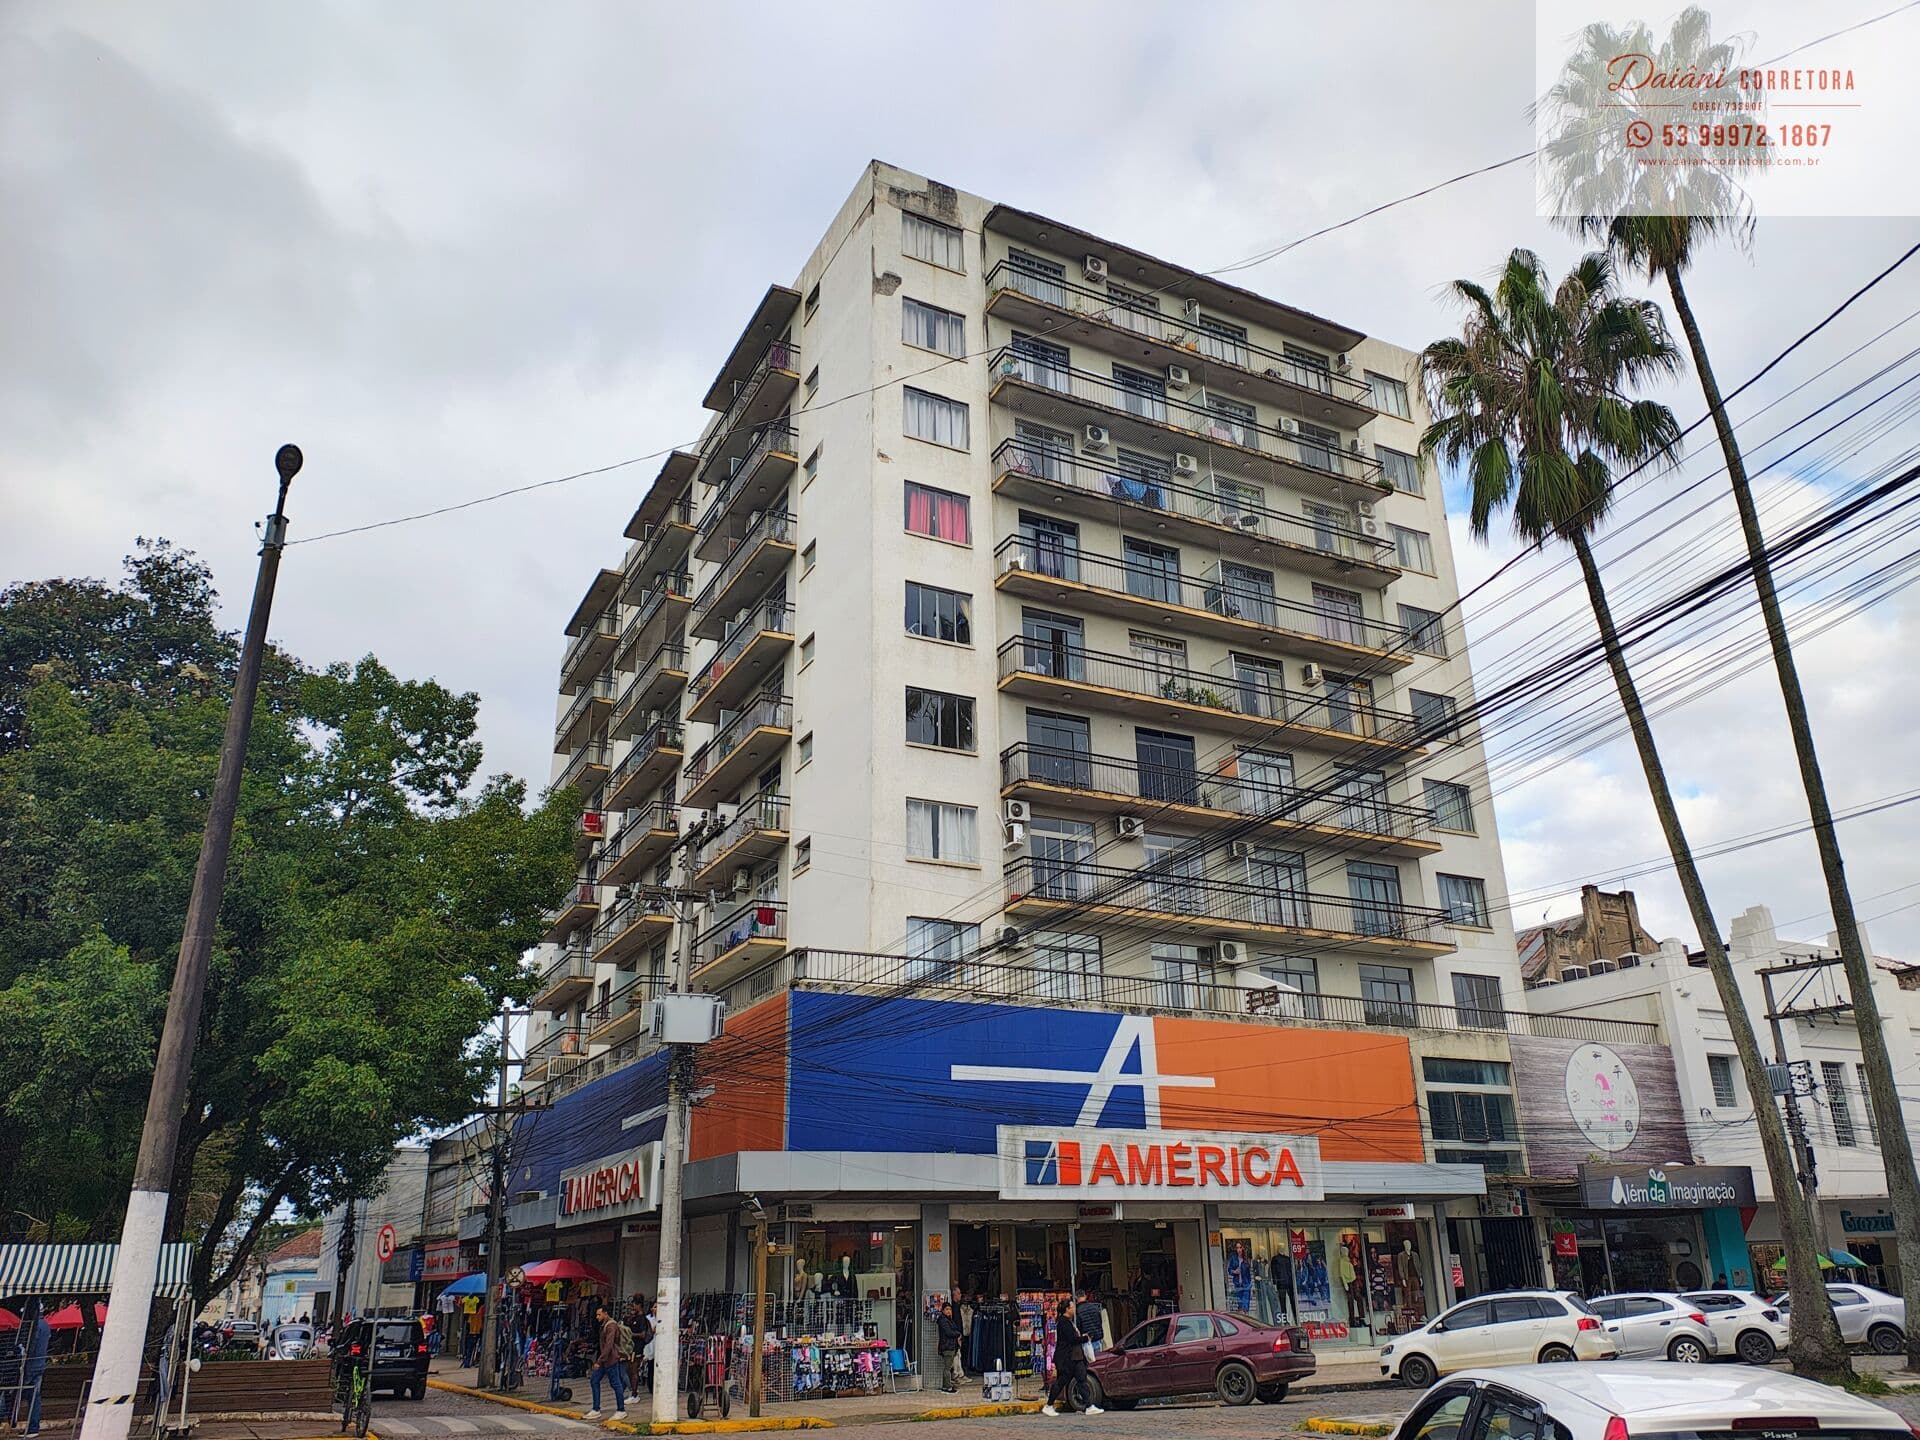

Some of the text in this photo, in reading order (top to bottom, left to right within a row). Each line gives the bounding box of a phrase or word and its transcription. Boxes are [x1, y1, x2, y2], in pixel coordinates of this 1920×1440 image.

[1088, 1137, 1305, 1187] AMÉRICA
[573, 1159, 641, 1212] AMÉRICA
[1611, 1176, 1736, 1205] Além da Imaginação
[1299, 1311, 1326, 1322] ESTILO
